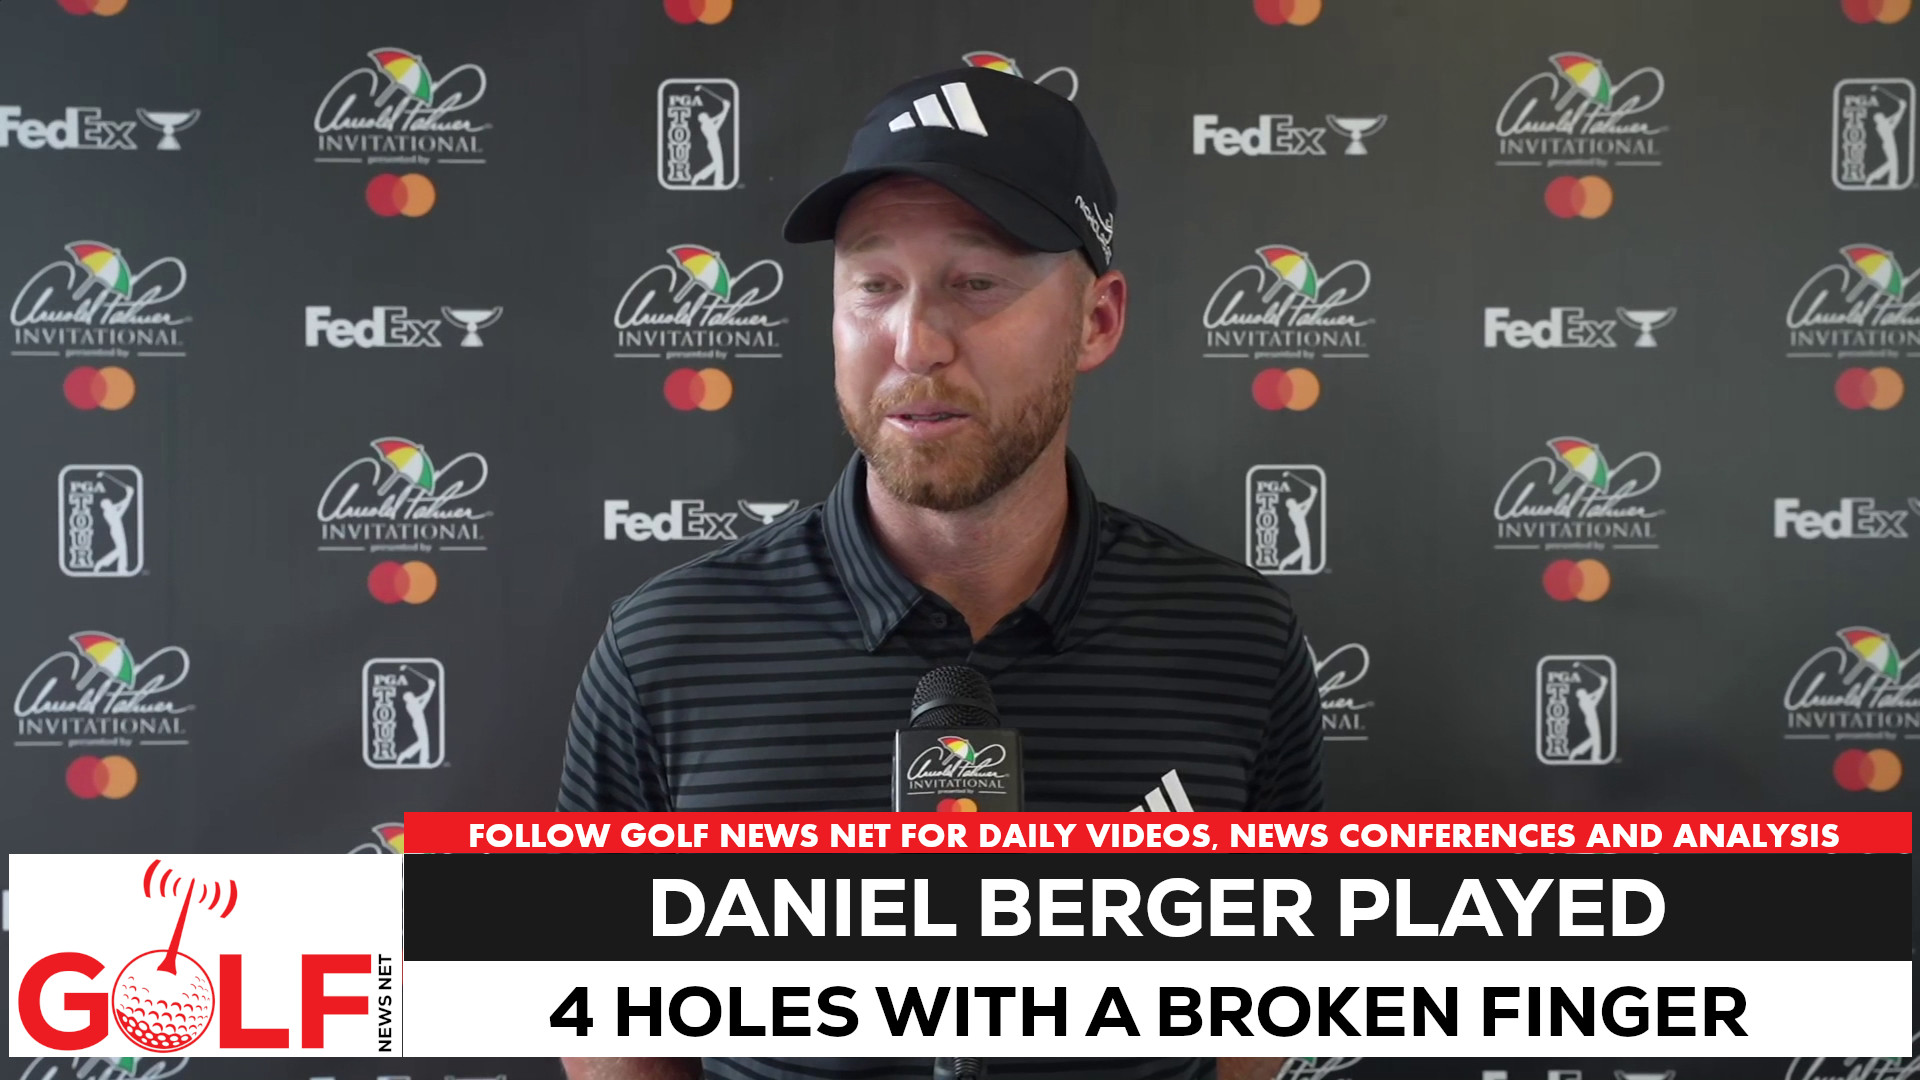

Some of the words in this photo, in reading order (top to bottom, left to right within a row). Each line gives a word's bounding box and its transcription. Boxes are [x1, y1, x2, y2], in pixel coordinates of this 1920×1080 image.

[314, 67, 410, 133] Arnold
[401, 63, 488, 132] Palmer
[669, 95, 703, 106] PGA
[1495, 72, 1589, 136] Arnold
[1580, 68, 1665, 135] Palmer
[1844, 95, 1878, 106] PGA
[0, 105, 138, 150] FedEx
[318, 134, 480, 152] INVITATIONAL
[667, 106, 692, 182] TOUR
[1193, 115, 1327, 156] FedEx
[1499, 137, 1658, 155] INVITATIONAL
[1842, 106, 1867, 182] TOUR
[10, 259, 108, 327] Arnold
[99, 255, 188, 326] Palmer
[614, 264, 708, 328] Arnold
[699, 260, 784, 327] Palmer
[1203, 264, 1296, 328] Arnold
[1287, 260, 1372, 327] Palmer
[1786, 264, 1880, 328] Arnold
[14, 328, 179, 346] INVITATIONAL
[305, 306, 442, 348] FedEx
[618, 329, 777, 347] INVITATIONAL
[1207, 329, 1364, 347] INVITATIONAL
[1484, 307, 1618, 348] FedEx
[1790, 329, 1920, 347] INVITATION
[71, 480, 106, 492] PGA
[317, 456, 412, 521] Arnold
[403, 452, 489, 520] Palmer
[1257, 481, 1291, 492] PGA
[1494, 455, 1587, 519] Arnold
[1578, 451, 1663, 518] Palmer
[69, 492, 95, 569] TOUR
[321, 522, 481, 540] INVITATIONAL
[604, 500, 739, 541] FedEx
[1255, 492, 1280, 567] TOUR
[1498, 520, 1655, 538] INVITATIONAL
[1774, 498, 1908, 539] FedEx
[15, 649, 112, 716] Arnold
[103, 645, 191, 715] Palmer
[374, 674, 408, 685] PGA
[1548, 672, 1581, 682] PGA
[1784, 646, 1878, 710] Arnold
[19, 717, 183, 735] INVITATIONAL
[372, 685, 397, 761] TOUR
[1546, 682, 1570, 757] TOUR
[1788, 711, 1920, 729] INVITATION
[907, 746, 962, 780] Arnold
[957, 744, 1006, 778] Palmer
[909, 779, 1005, 789] INVITATIONAL
